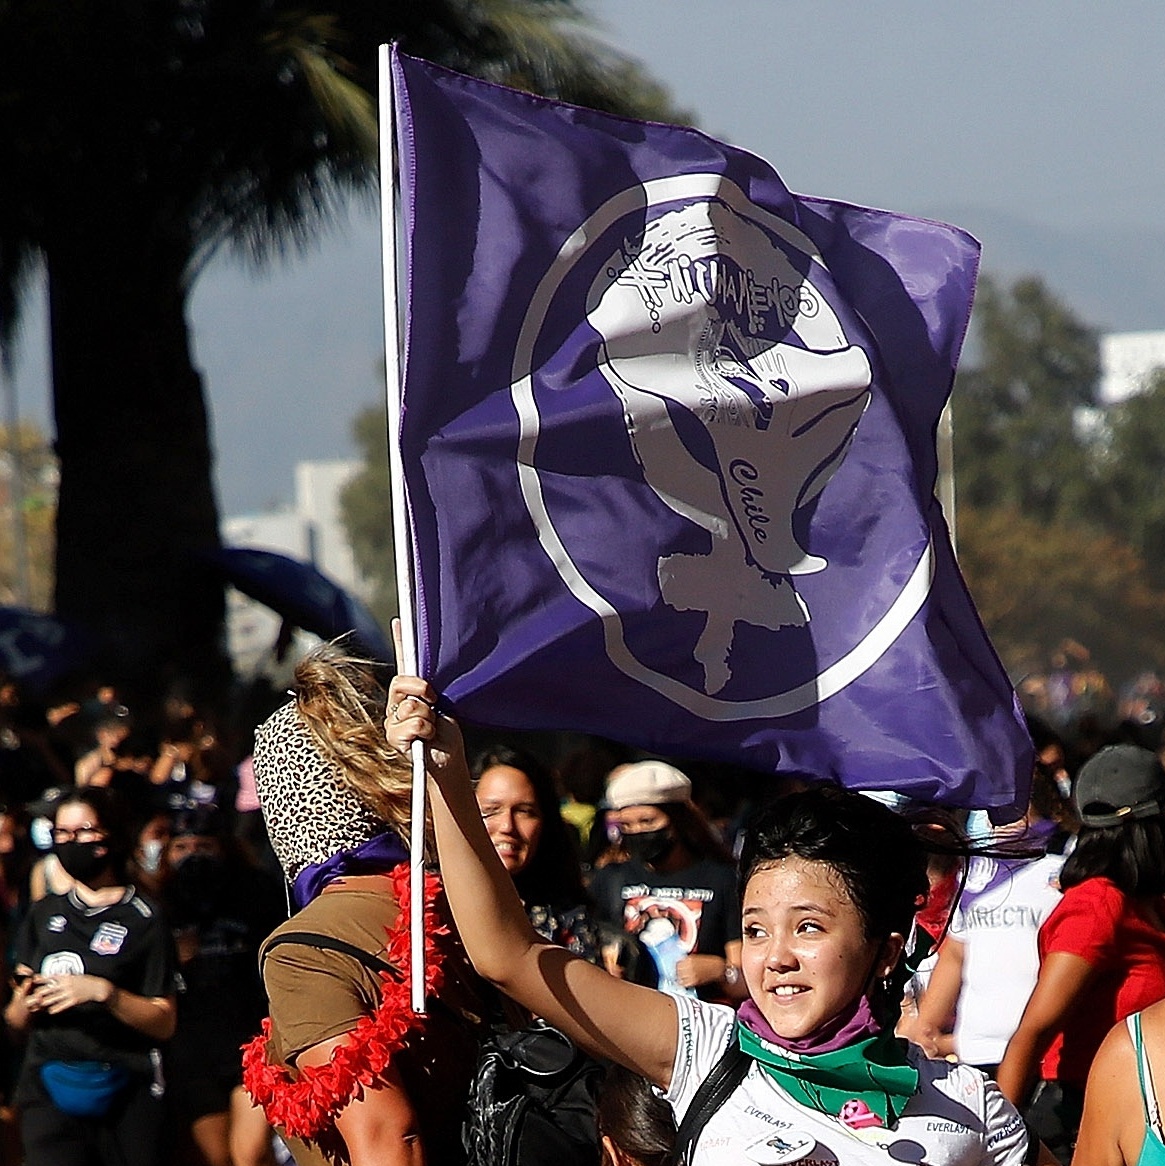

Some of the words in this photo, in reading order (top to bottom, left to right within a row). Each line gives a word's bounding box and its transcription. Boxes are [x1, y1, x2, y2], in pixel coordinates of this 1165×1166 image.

[729, 459, 770, 544] Chile
[743, 1105, 794, 1130] EVERLAST
[927, 1122, 970, 1134] EVERLAST
